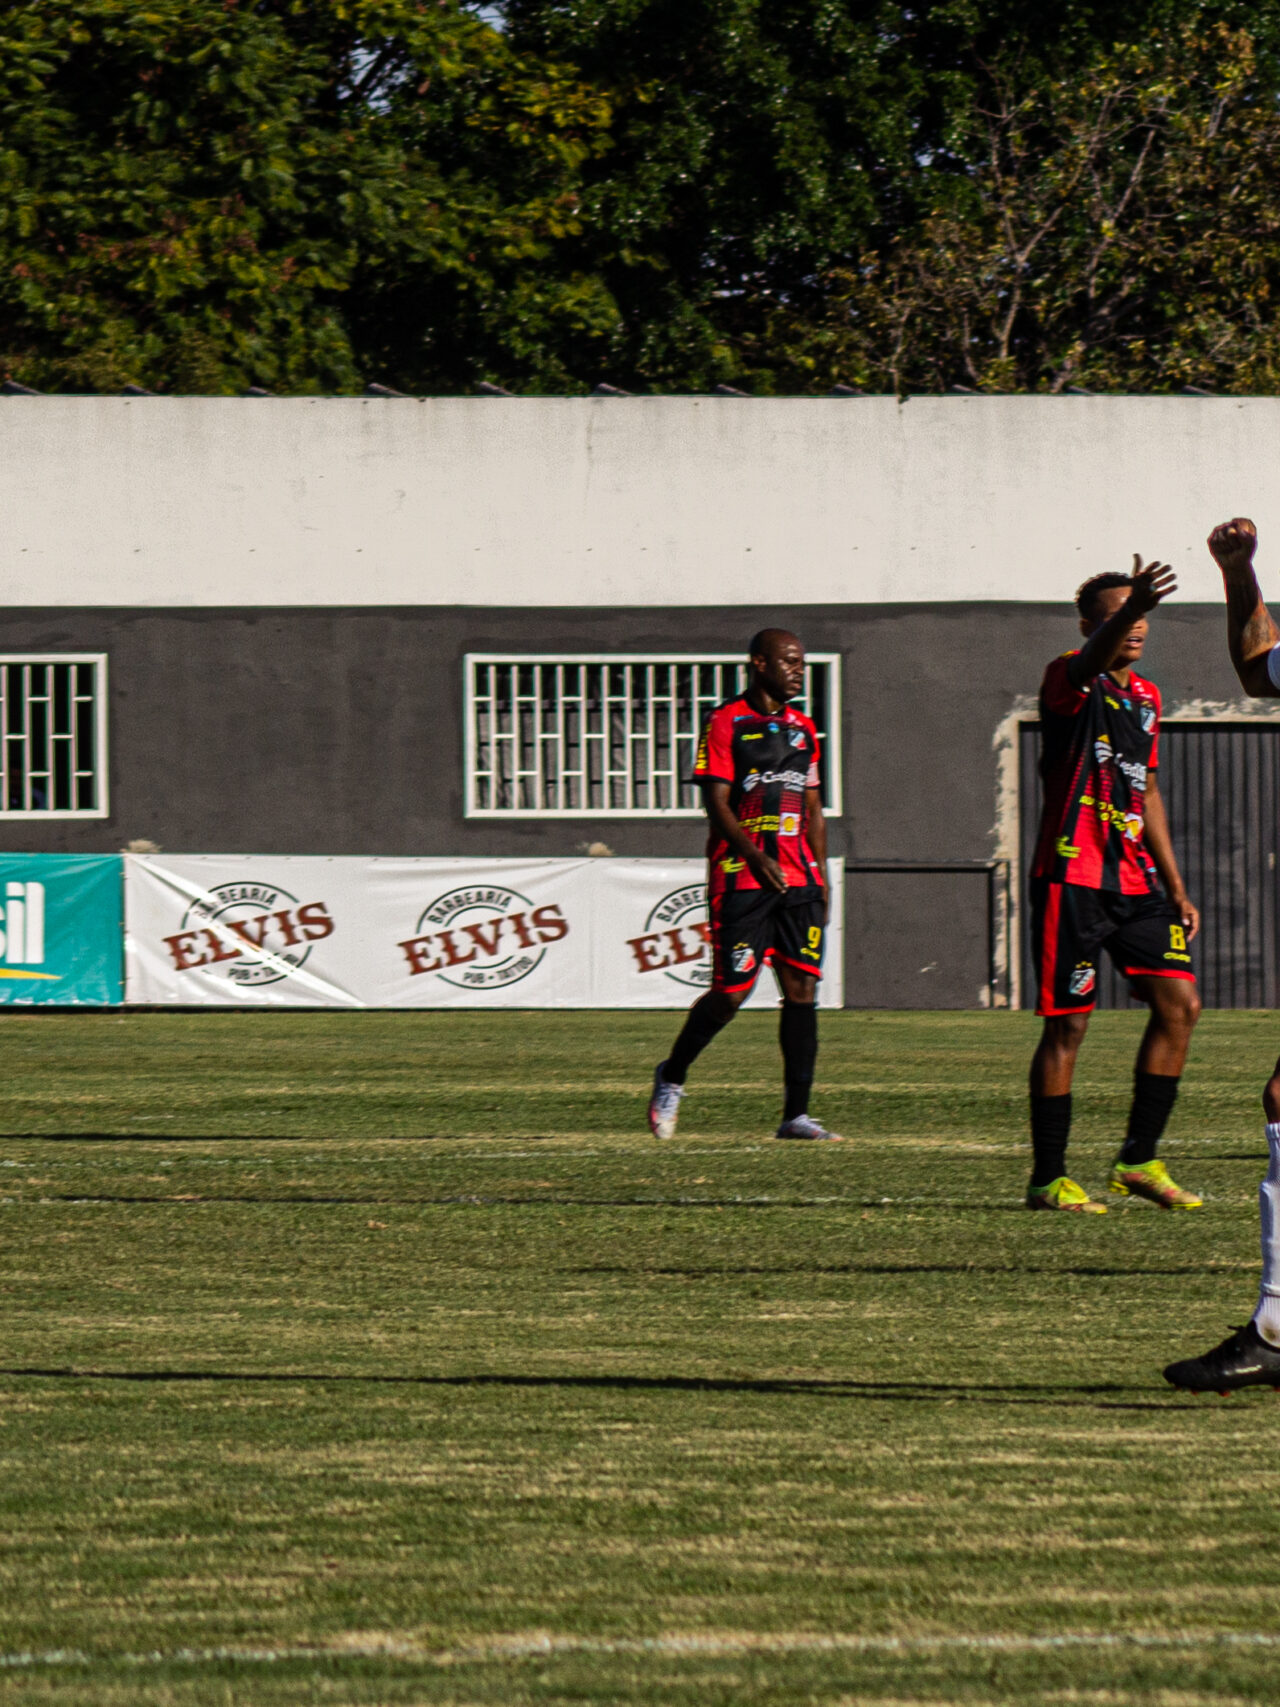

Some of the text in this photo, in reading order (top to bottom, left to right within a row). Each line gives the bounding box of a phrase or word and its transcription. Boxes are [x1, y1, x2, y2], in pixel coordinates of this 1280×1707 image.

[427, 890, 513, 924] BARBEARIA
[656, 889, 702, 922] BARBE
[162, 902, 335, 971] ELVIS
[397, 904, 569, 976] ELVIS
[808, 926, 821, 948] 9
[1169, 924, 1186, 950] 8
[463, 972, 486, 984] PUB
